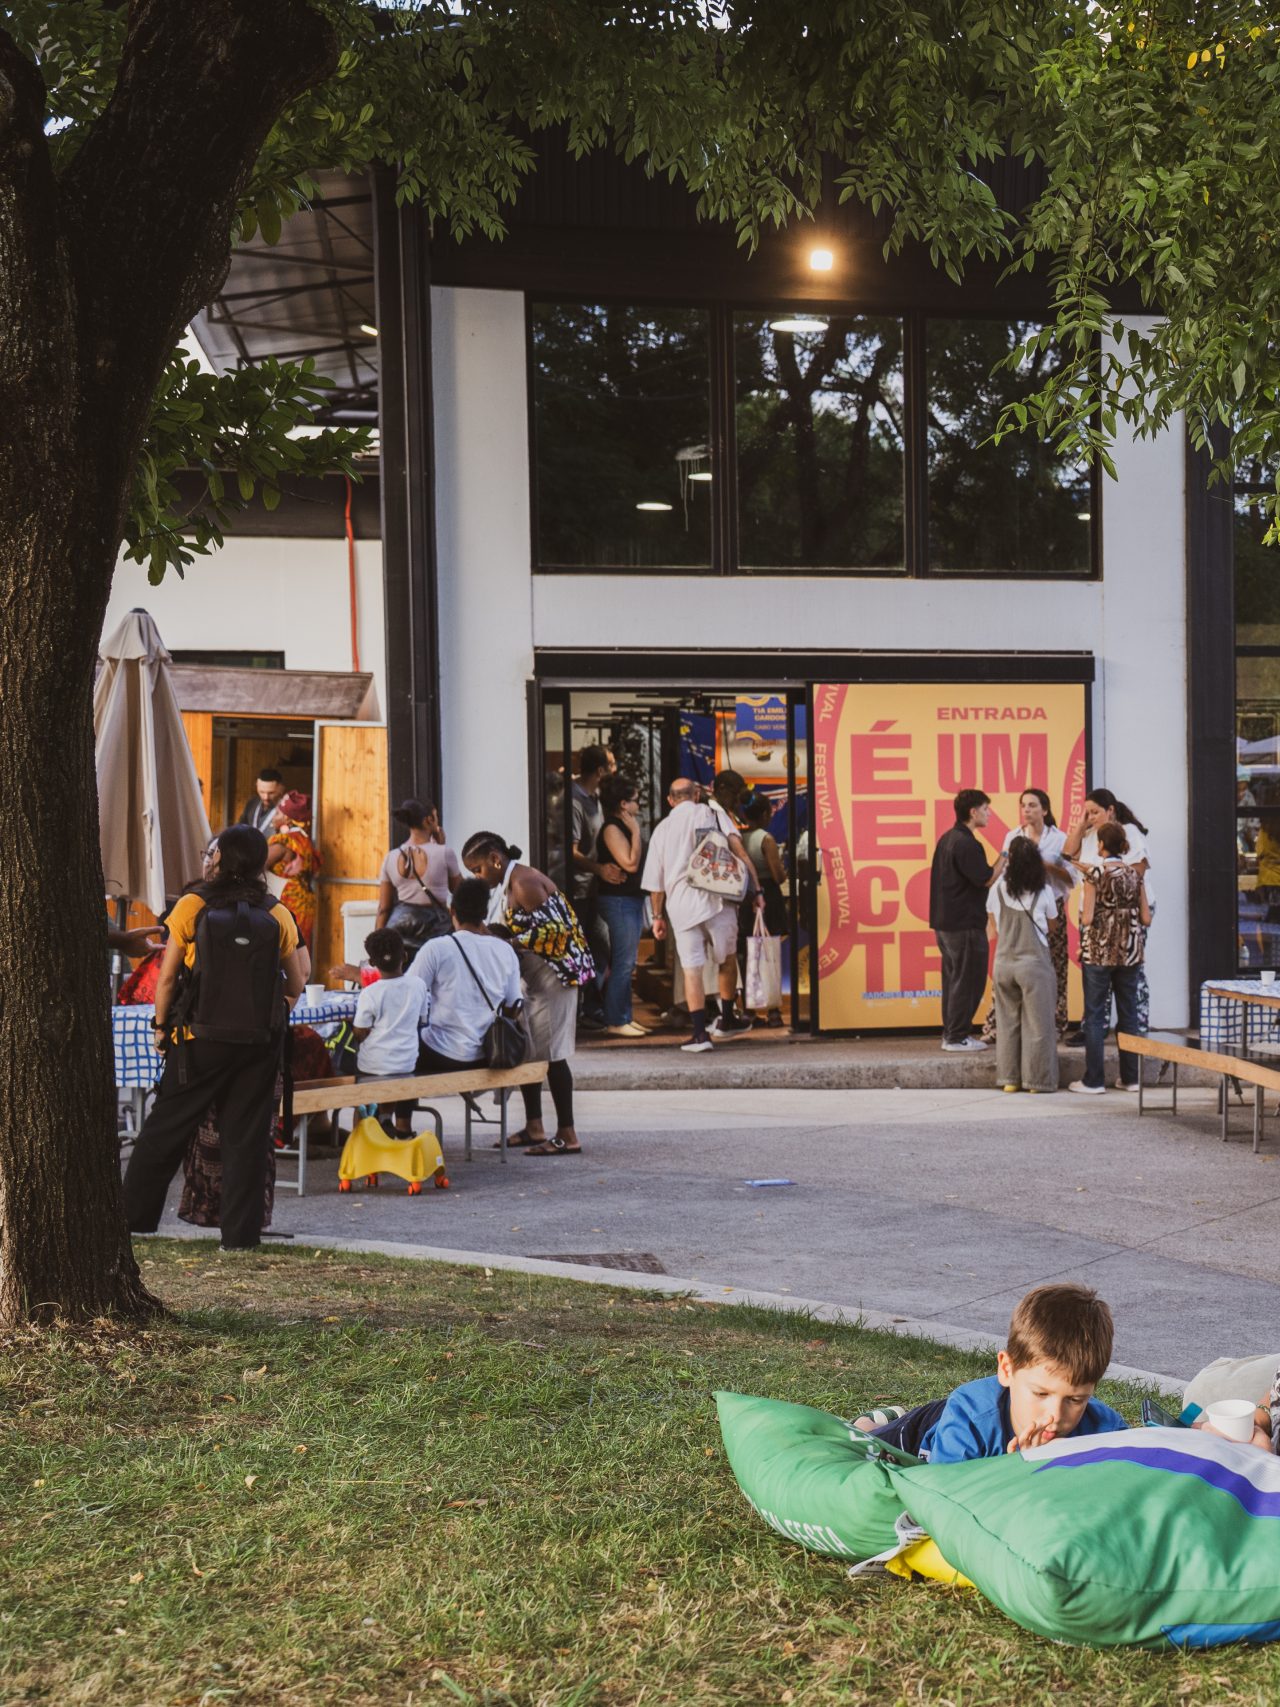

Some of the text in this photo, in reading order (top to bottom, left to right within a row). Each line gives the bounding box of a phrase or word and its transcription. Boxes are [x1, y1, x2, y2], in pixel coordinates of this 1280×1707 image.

[937, 707, 1048, 720] ENTRADA
[815, 743, 833, 829] FESTIVAL
[851, 720, 1048, 795] É UM
[828, 846, 849, 929] FESTIVAL
